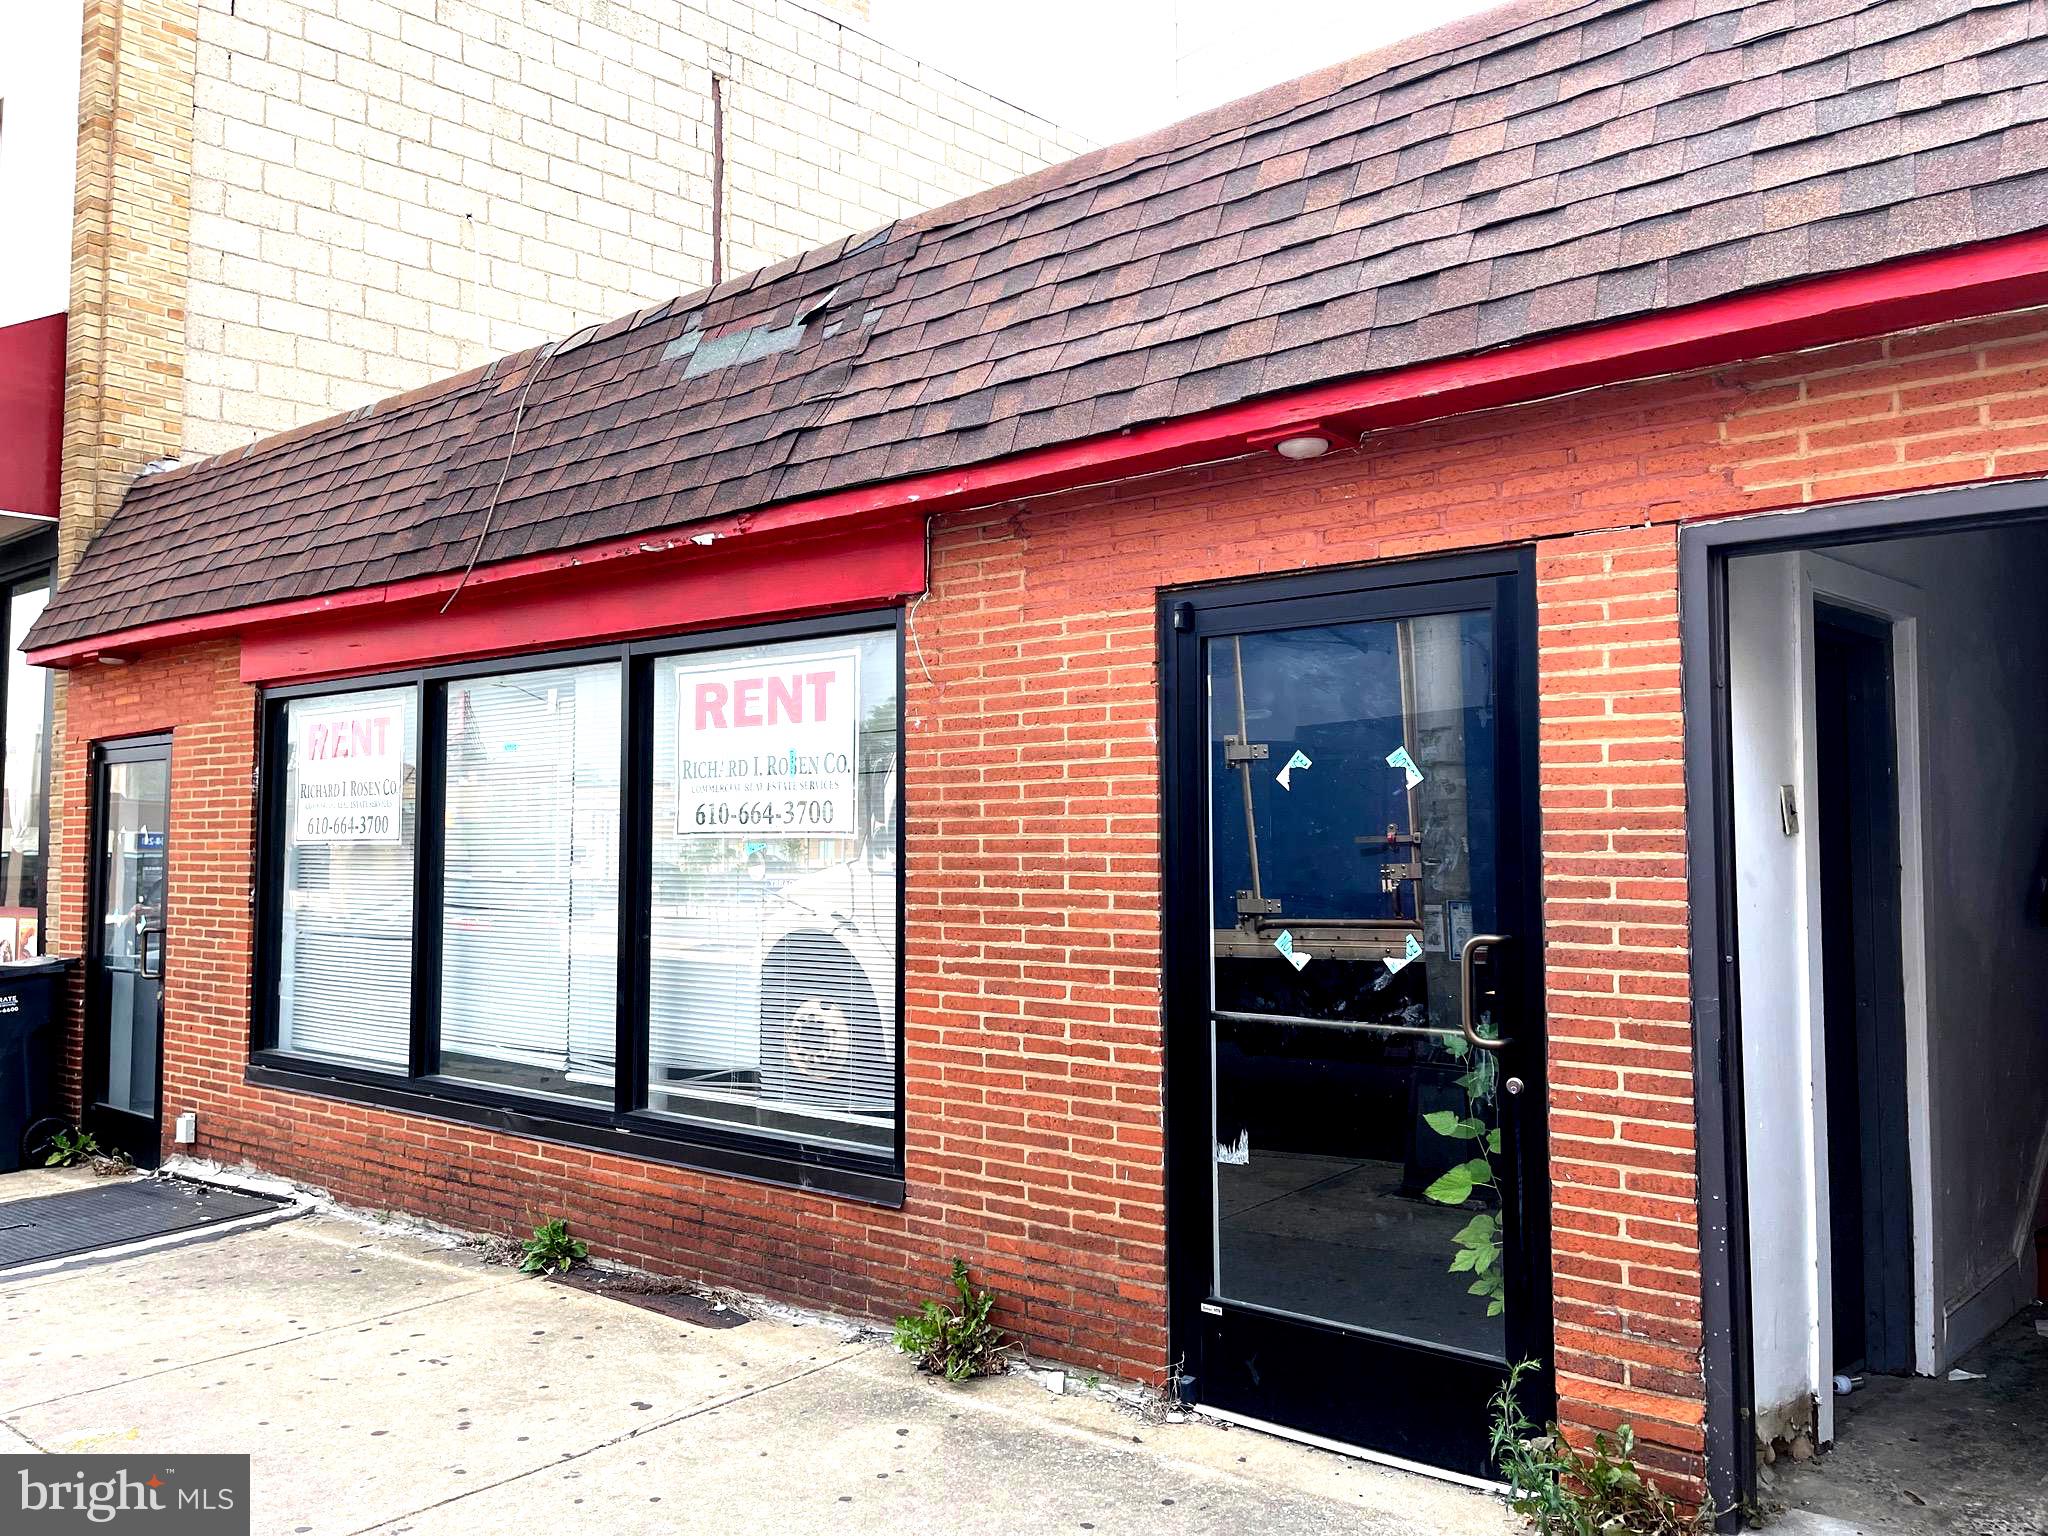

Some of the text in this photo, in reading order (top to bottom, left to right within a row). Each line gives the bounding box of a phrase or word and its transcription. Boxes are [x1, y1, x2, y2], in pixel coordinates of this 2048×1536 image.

[695, 671, 836, 730] RENT
[308, 717, 391, 760] RENT
[300, 783, 341, 799] RICHARD
[350, 780, 381, 797] ROSEN
[307, 815, 389, 835] 610-664-3700
[695, 800, 834, 825] 610-664-3700
